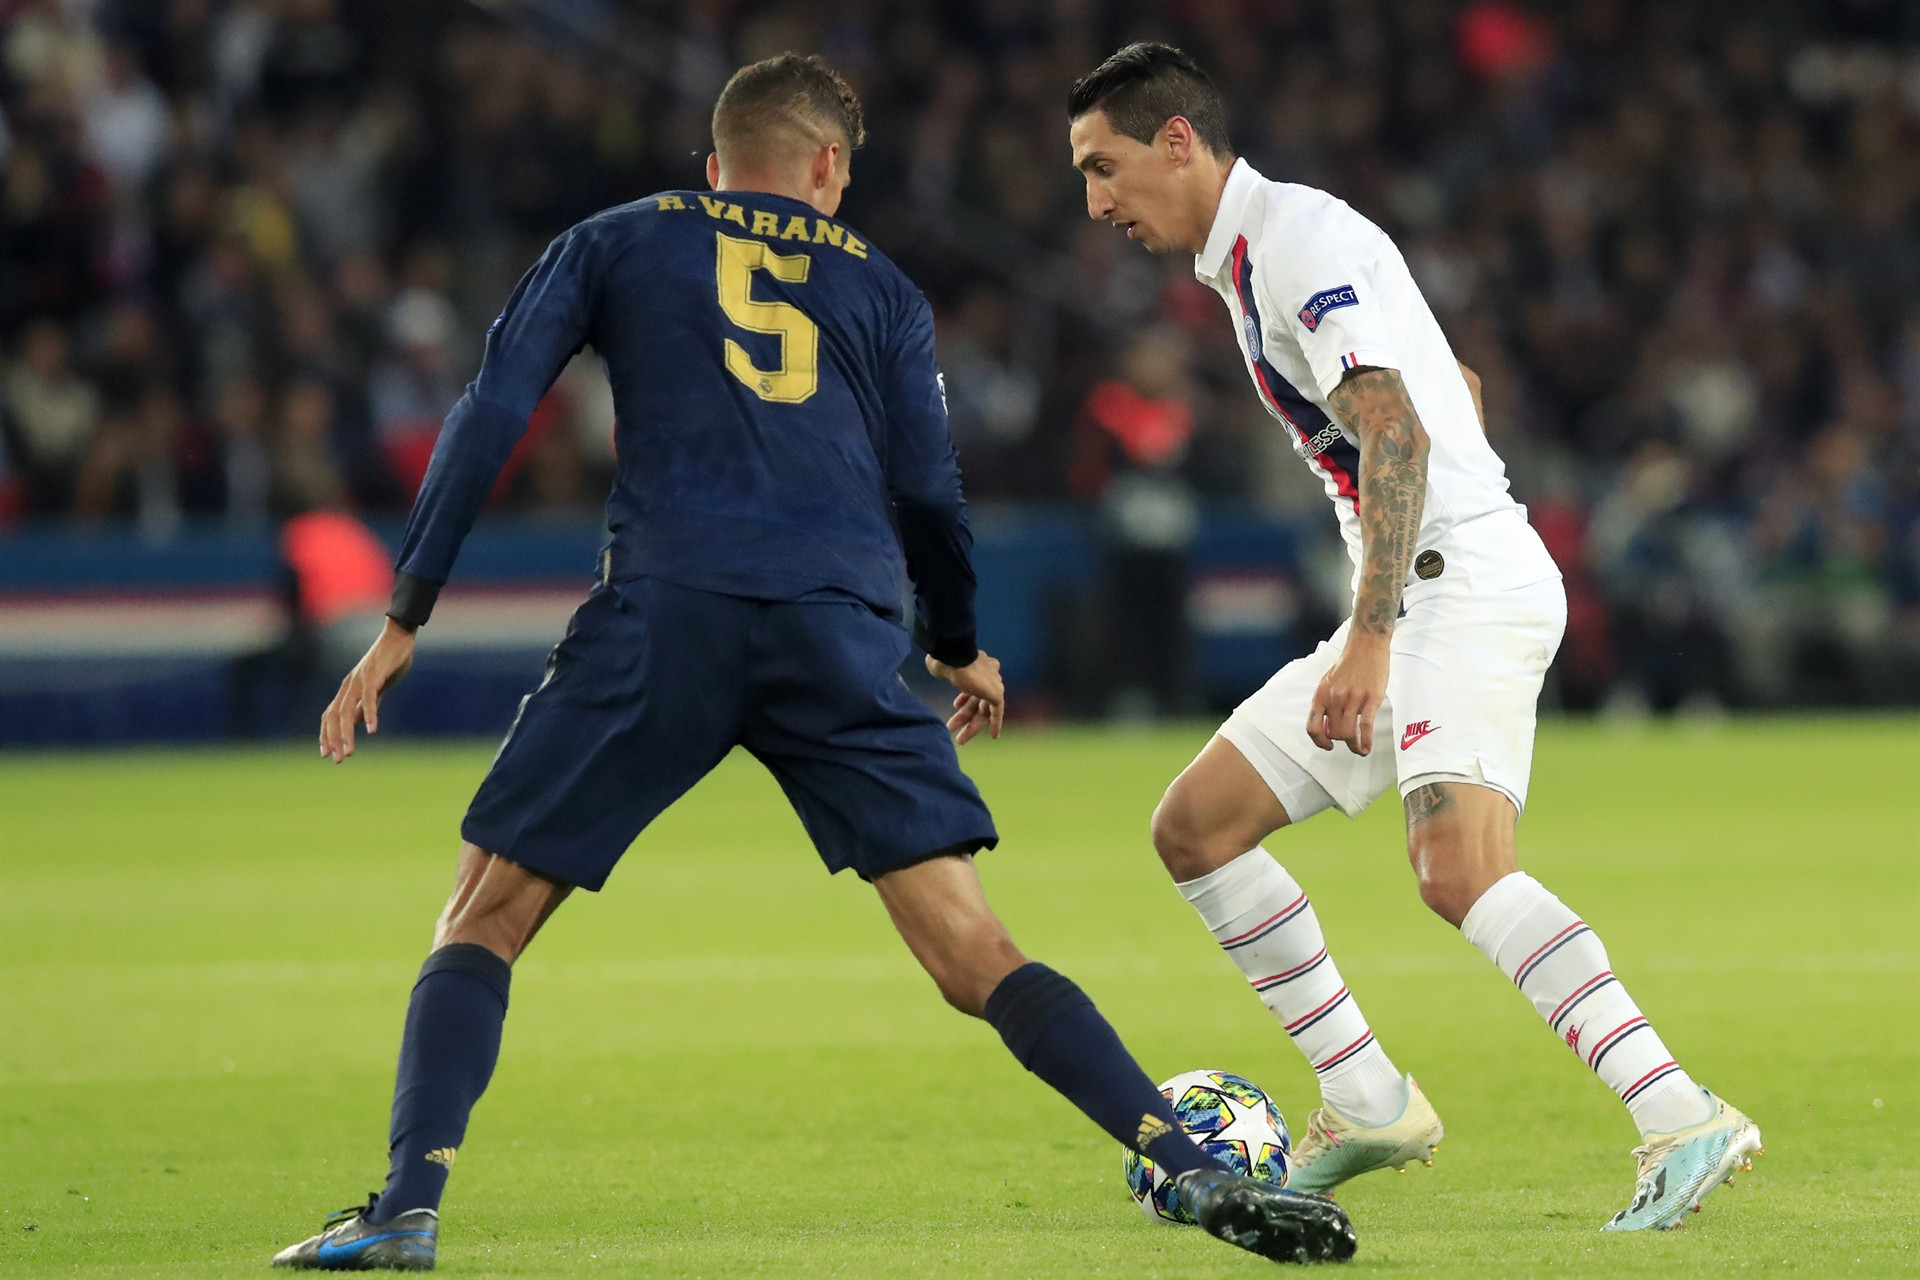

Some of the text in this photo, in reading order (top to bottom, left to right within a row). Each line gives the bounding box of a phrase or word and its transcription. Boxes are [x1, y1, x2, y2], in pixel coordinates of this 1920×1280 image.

[716, 230, 819, 404] 5
[1309, 289, 1356, 317] RESPECT
[1404, 719, 1431, 739] NIKE
